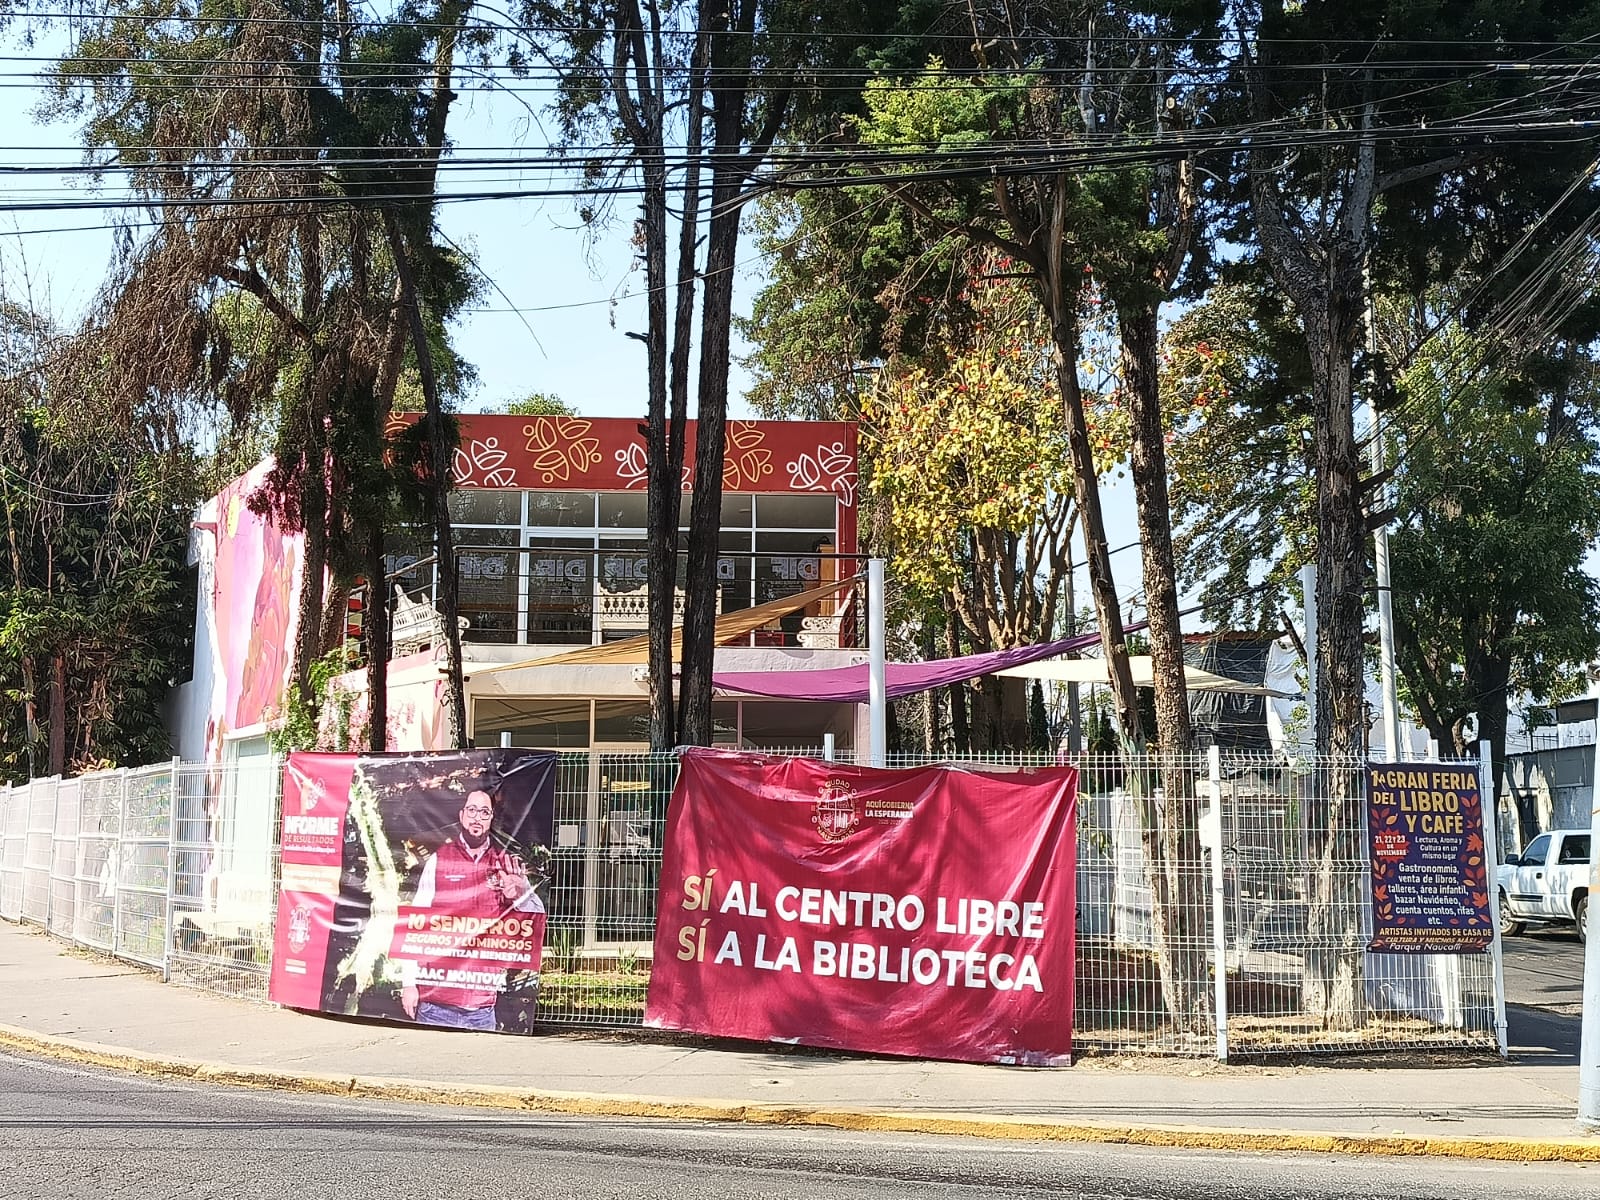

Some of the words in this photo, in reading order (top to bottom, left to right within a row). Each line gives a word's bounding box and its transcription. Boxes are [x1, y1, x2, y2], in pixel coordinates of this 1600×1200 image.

[1386, 770, 1428, 789] GRAN
[1432, 772, 1477, 790] FERIA
[865, 799, 882, 809] AQUÍ
[882, 800, 914, 810] GOBIERNA
[1373, 791, 1397, 805] DEL
[1400, 791, 1459, 813] LIBRO
[874, 810, 914, 819] ESPERANZA
[284, 815, 339, 835] INFORME
[1406, 815, 1417, 833] Y
[1421, 811, 1464, 834] CAFÉ
[293, 835, 335, 845] RESULTADOS
[1415, 836, 1439, 845] Lectura,
[1419, 844, 1441, 852] Cultura
[1442, 852, 1457, 861] lugar
[1398, 874, 1421, 884] venta
[1422, 874, 1433, 884] de
[1435, 874, 1459, 885] libros,
[1388, 884, 1419, 895] talleres,
[1439, 885, 1469, 896] infantil,
[680, 868, 717, 912] SÍ
[719, 880, 767, 918] AL
[774, 886, 925, 931] CENTRO
[936, 897, 1044, 939] LIBRE
[1395, 894, 1416, 904] bazar
[1395, 907, 1422, 915] cuenta
[1423, 906, 1457, 917] cuentos,
[1457, 906, 1475, 915] rifas
[429, 914, 534, 938] SENDEROS
[1427, 917, 1443, 925] etc.
[1379, 928, 1413, 936] ARTISTAS
[1414, 928, 1451, 936] INVITADOS
[1452, 928, 1461, 936] DE
[1462, 928, 1481, 936] CASA
[1483, 928, 1493, 937] DE
[405, 932, 452, 946] SEGUROS
[462, 938, 533, 951] LUMINOSOS
[1389, 943, 1421, 952] Parque
[1423, 943, 1462, 951] Naucalli
[401, 944, 422, 955] PARA
[480, 949, 532, 963] BIENESTAR
[676, 920, 707, 962] SÍ
[714, 930, 743, 967] A
[754, 934, 802, 973] LA
[812, 940, 1044, 993] BIBLIOTECA
[446, 969, 508, 986] MONTOYA
